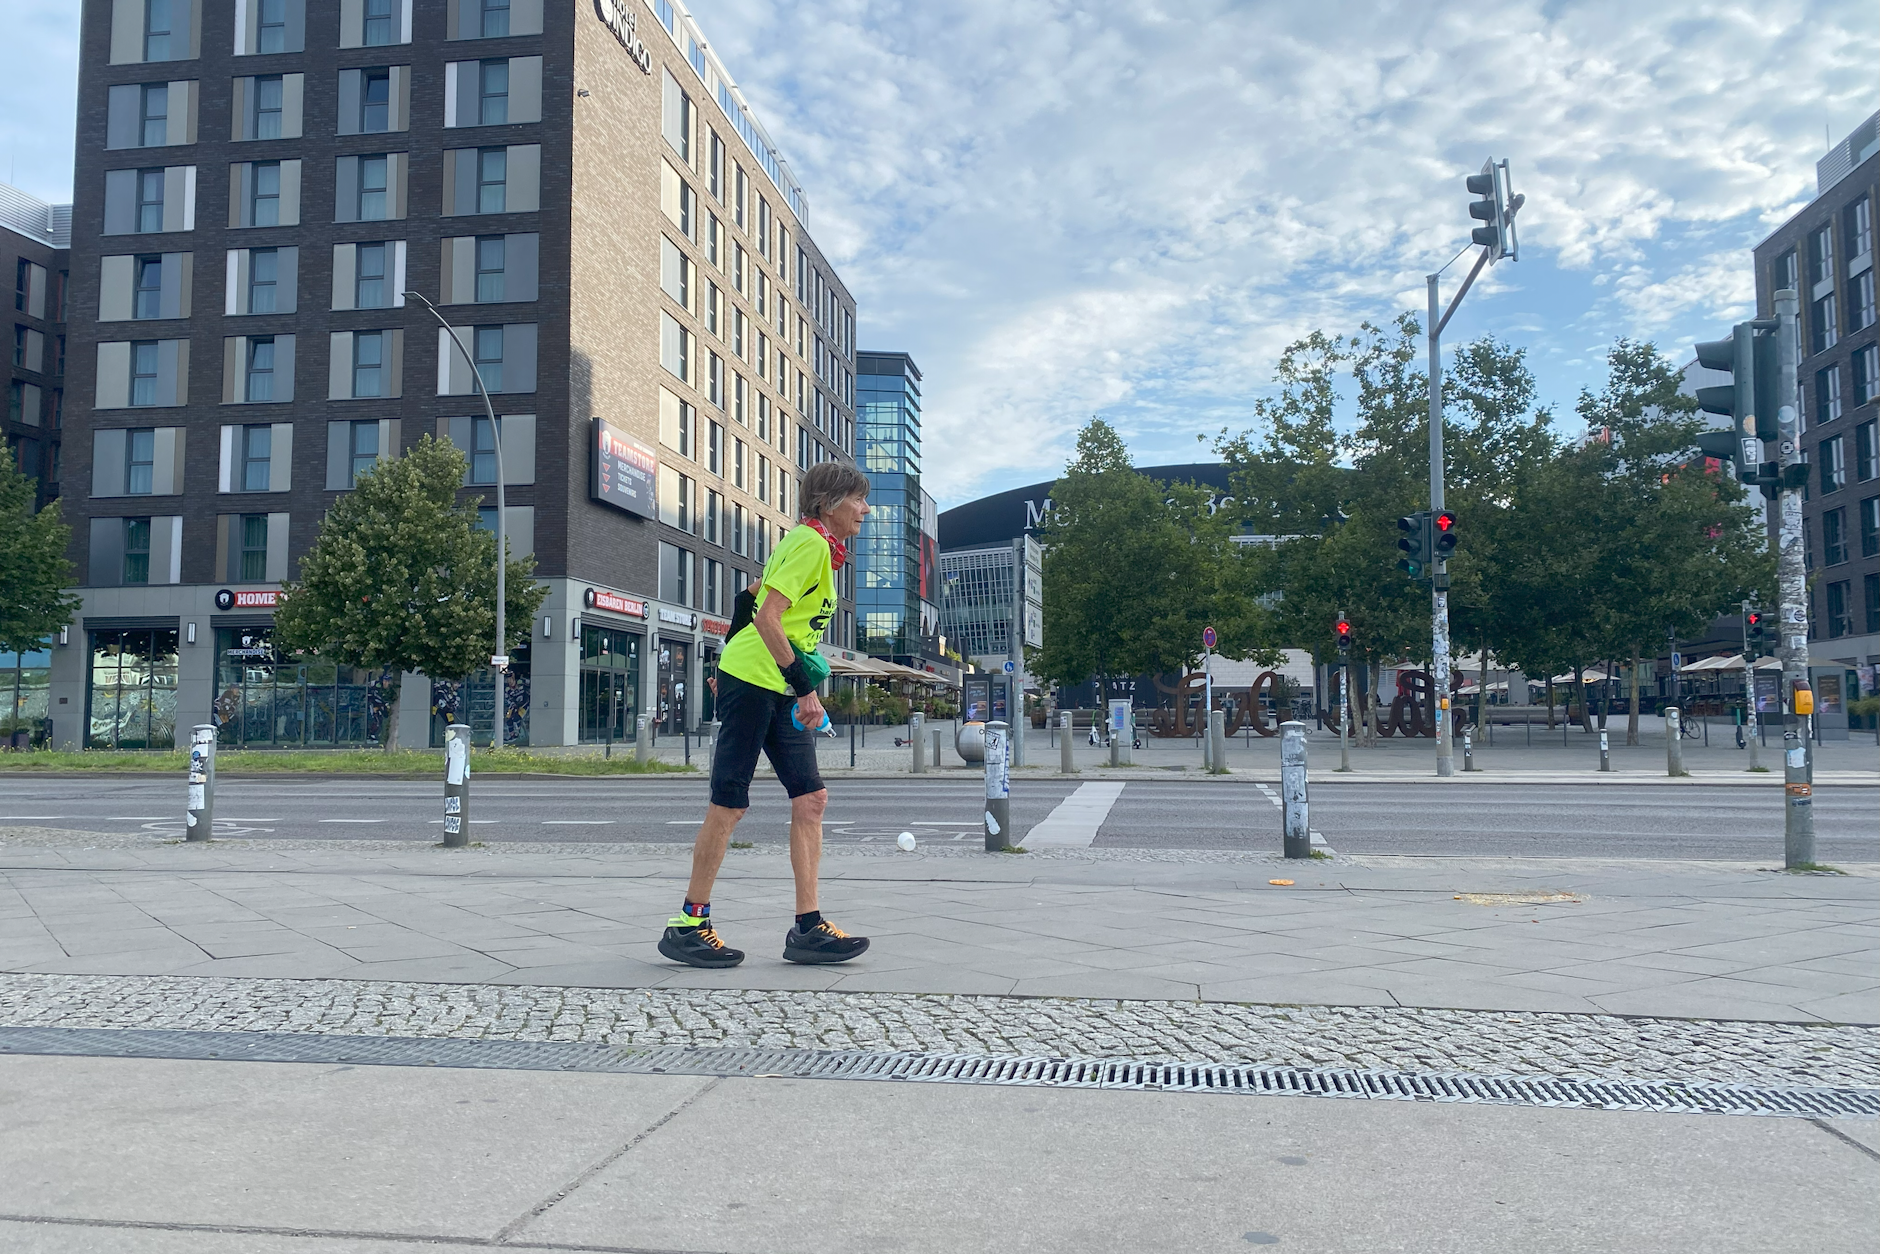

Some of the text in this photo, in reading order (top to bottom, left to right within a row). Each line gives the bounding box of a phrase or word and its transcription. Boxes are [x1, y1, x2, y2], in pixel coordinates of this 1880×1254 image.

[613, 8, 652, 73] INDIGO
[613, 440, 655, 473] TEAMSTORE
[617, 460, 646, 482] MERCHANDISE
[617, 472, 632, 486] TICKETS
[237, 593, 276, 605] HOME
[596, 592, 643, 615] EISBÄREN BERLIN
[227, 648, 265, 656] MERCHANDISE
[1092, 681, 1136, 691] PATZ
